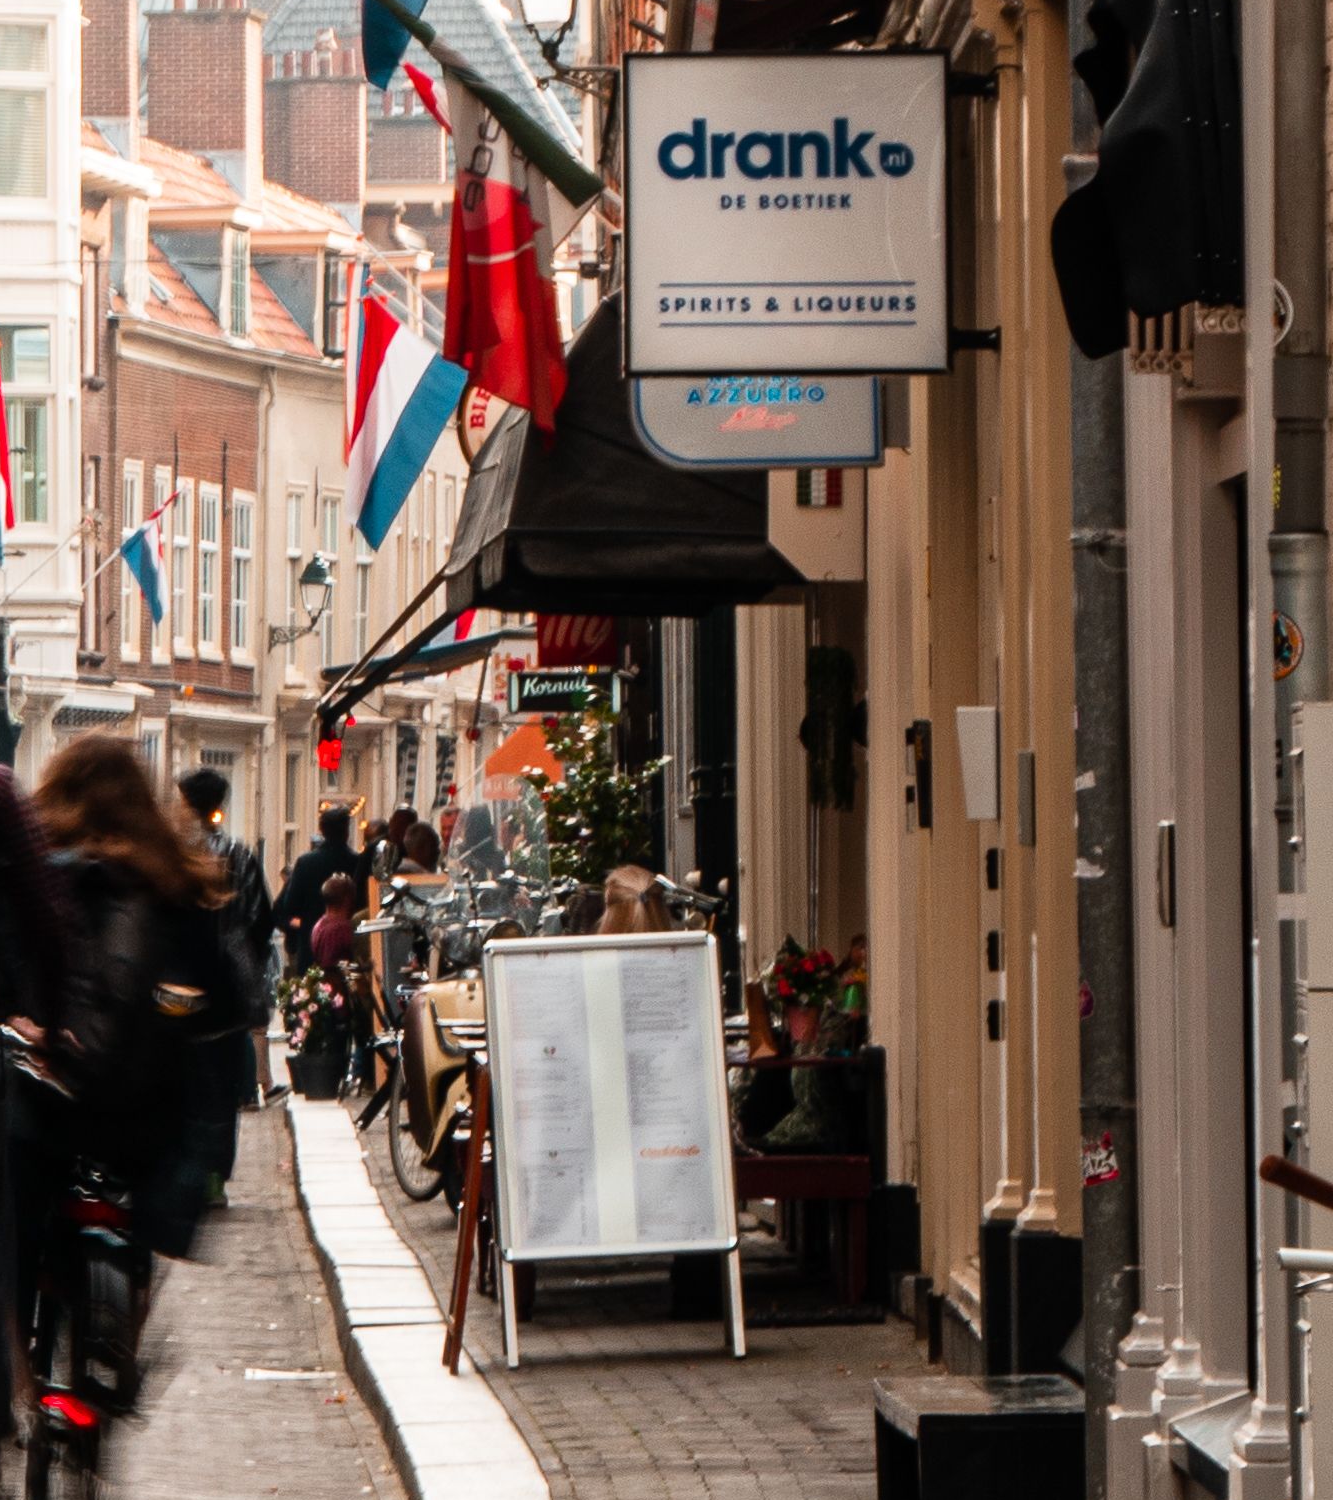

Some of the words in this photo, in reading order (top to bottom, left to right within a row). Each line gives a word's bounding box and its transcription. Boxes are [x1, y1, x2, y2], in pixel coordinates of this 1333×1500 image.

[657, 116, 876, 180] drank
[719, 194, 746, 210] DE
[758, 193, 852, 210] BOETIEK
[658, 296, 752, 313] SPIRITS
[764, 297, 780, 313] &
[793, 295, 917, 313] LIQUEURS
[687, 385, 826, 404] AZZURRO
